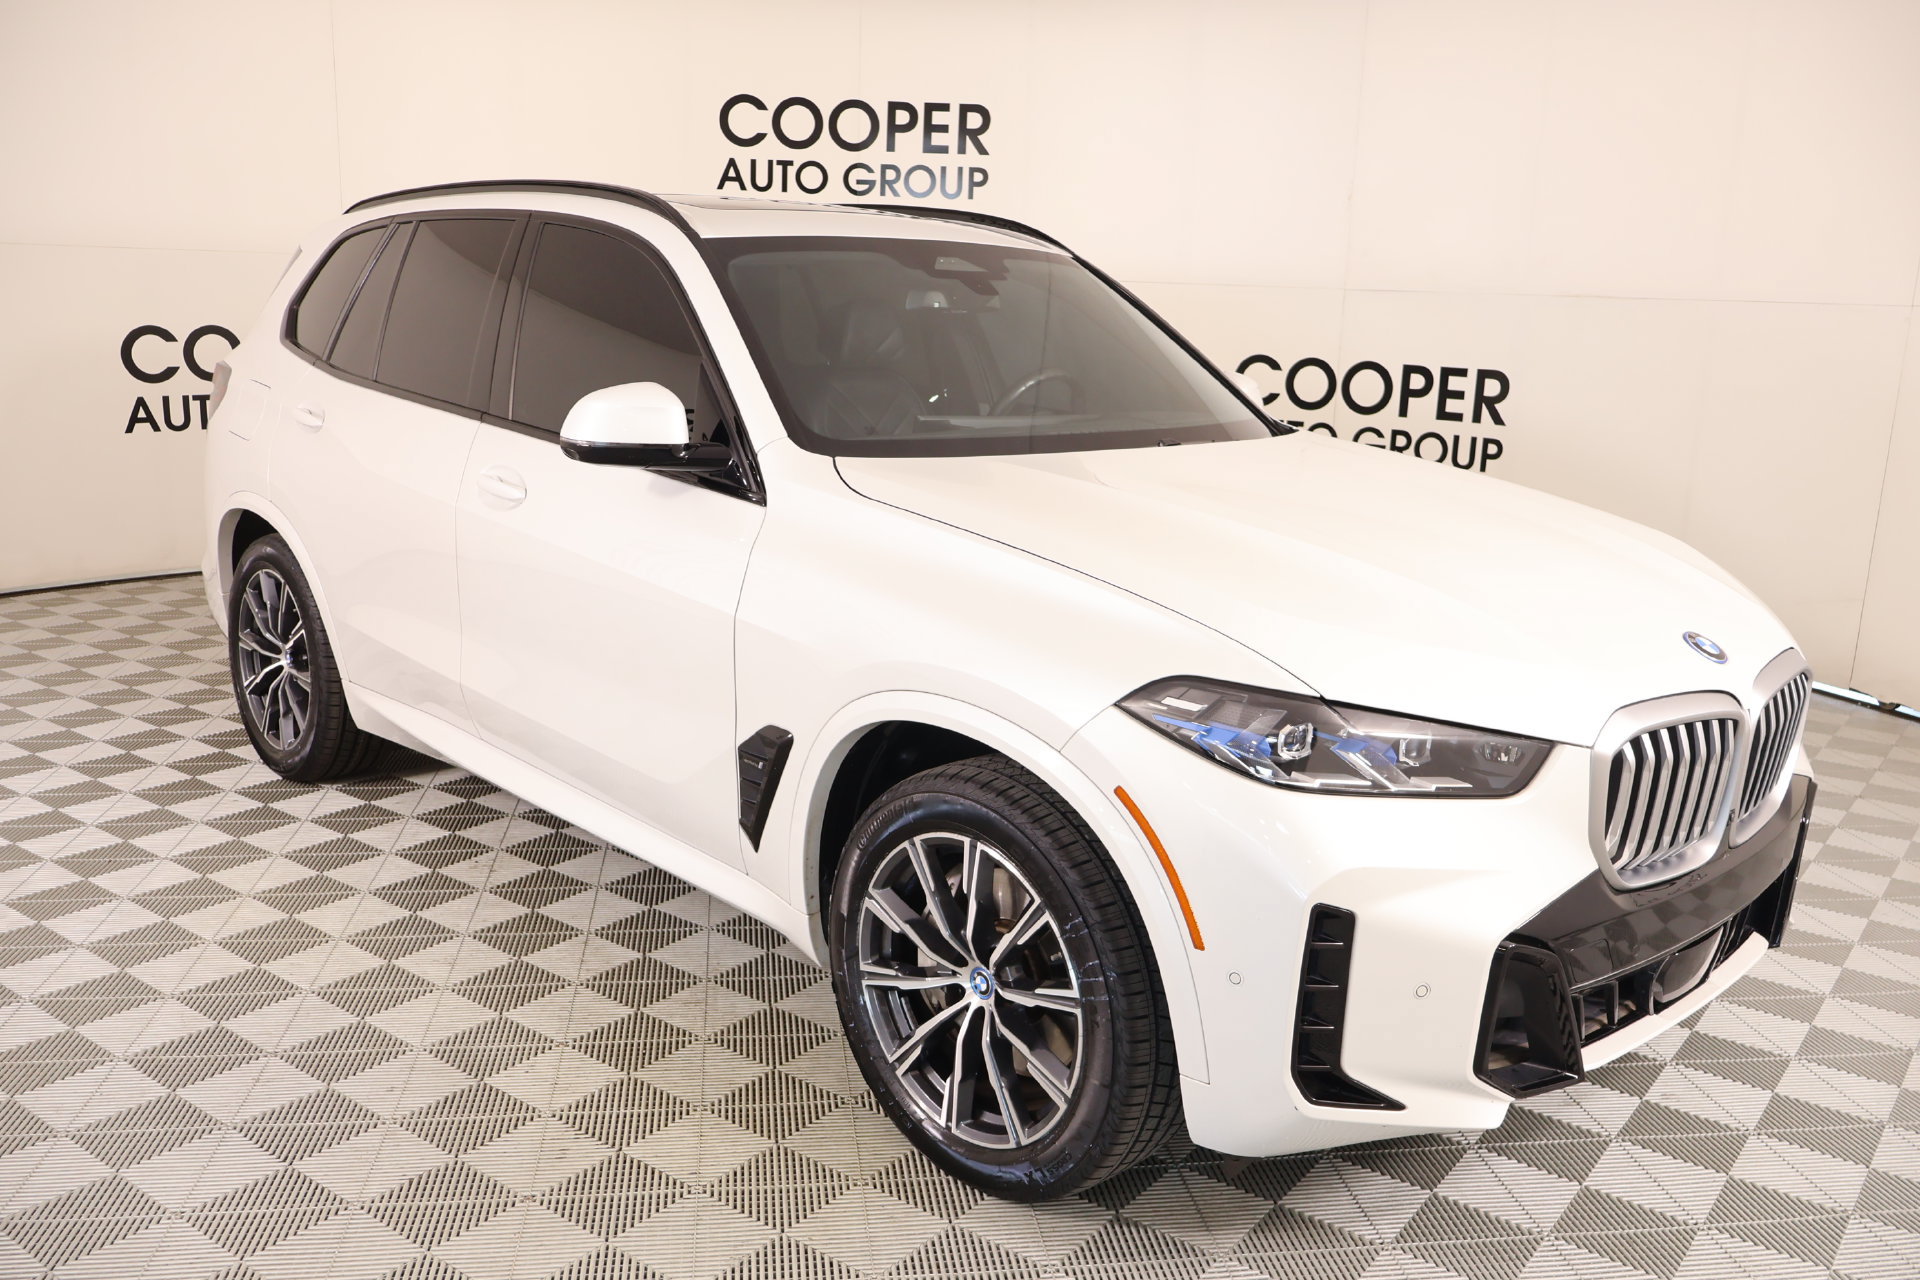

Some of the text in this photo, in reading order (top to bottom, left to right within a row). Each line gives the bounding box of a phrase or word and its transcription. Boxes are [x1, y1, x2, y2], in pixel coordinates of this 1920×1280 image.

[719, 94, 991, 156] COOPER
[717, 158, 989, 200] AUTO GROUP
[1236, 354, 1510, 427] COOPER
